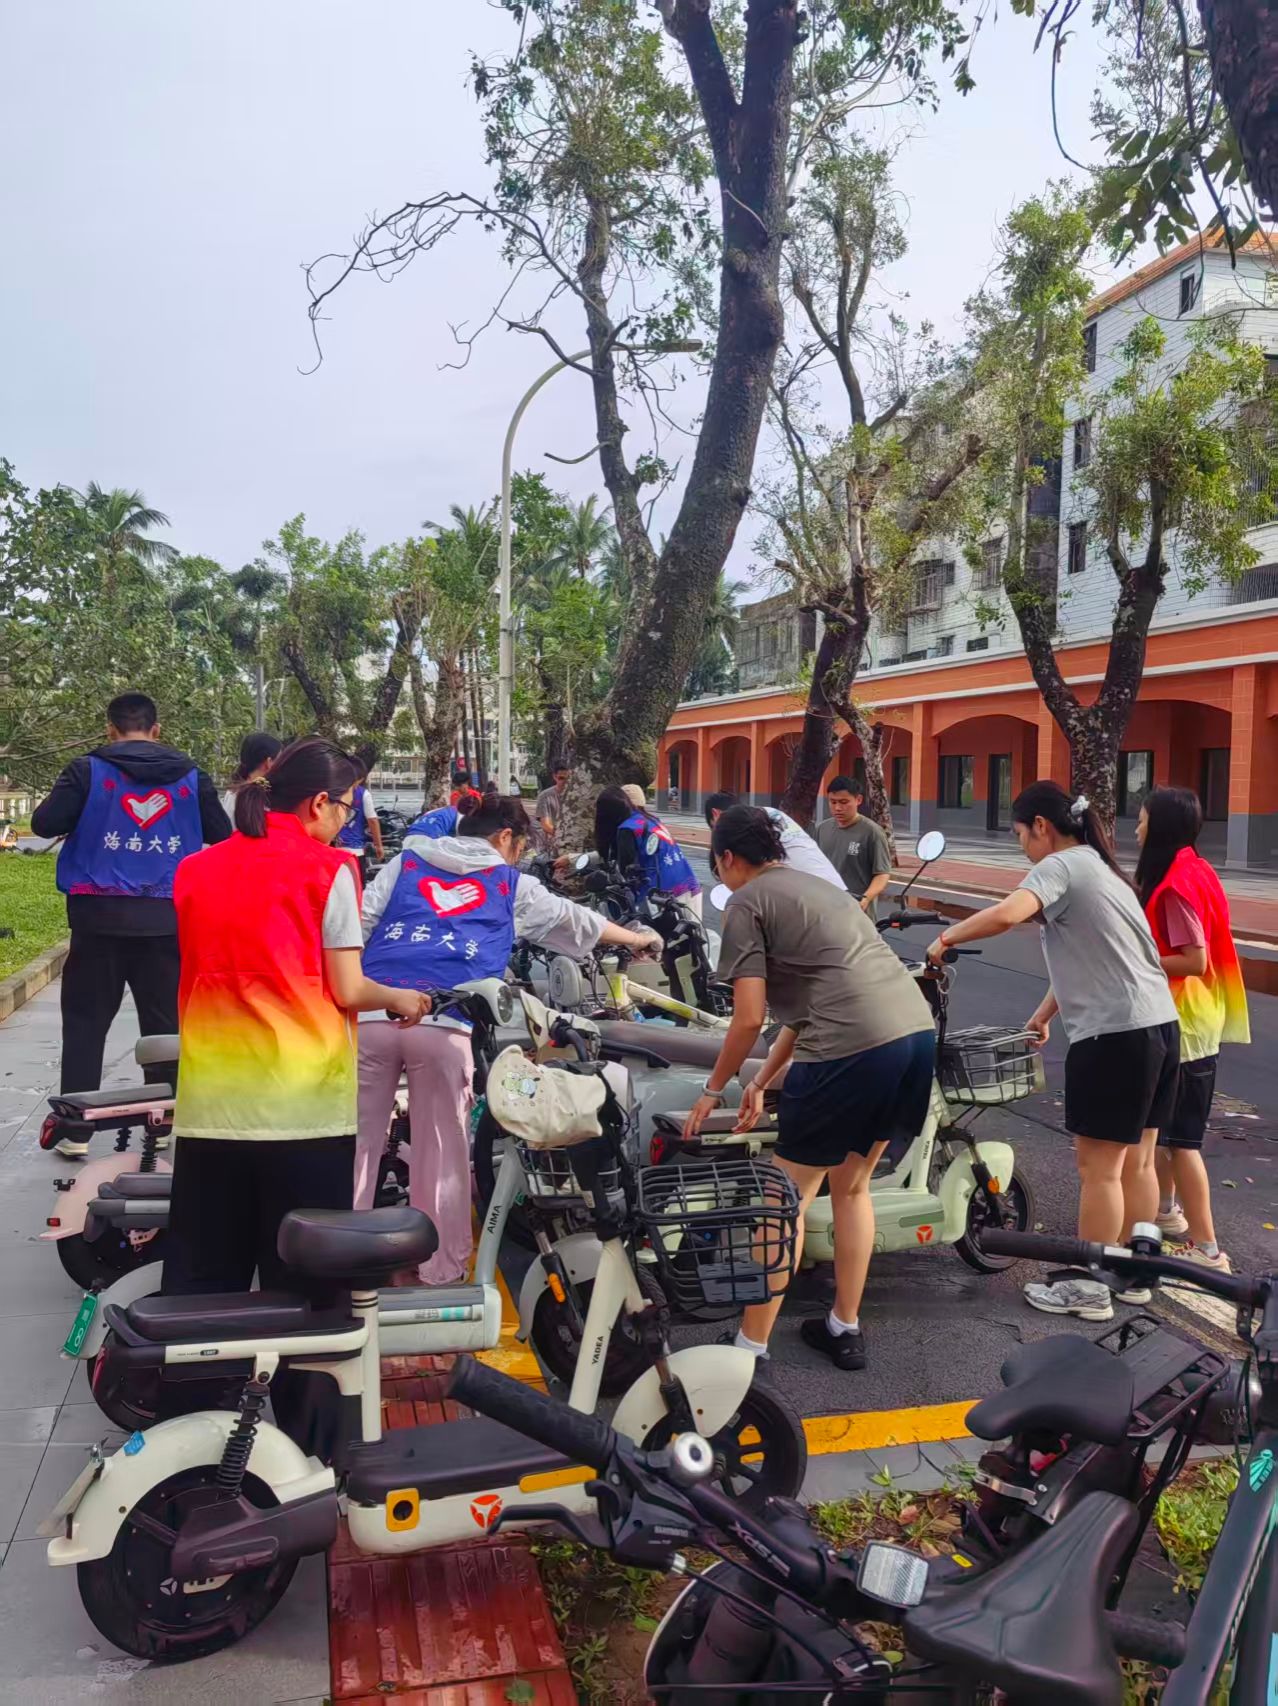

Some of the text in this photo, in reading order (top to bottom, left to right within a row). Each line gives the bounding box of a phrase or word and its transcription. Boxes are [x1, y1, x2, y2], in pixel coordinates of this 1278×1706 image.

[103, 830, 182, 854] 海南大学
[383, 921, 479, 960] 海南大学
[487, 1205, 503, 1234] AIMA
[591, 1335, 605, 1365] YADEA
